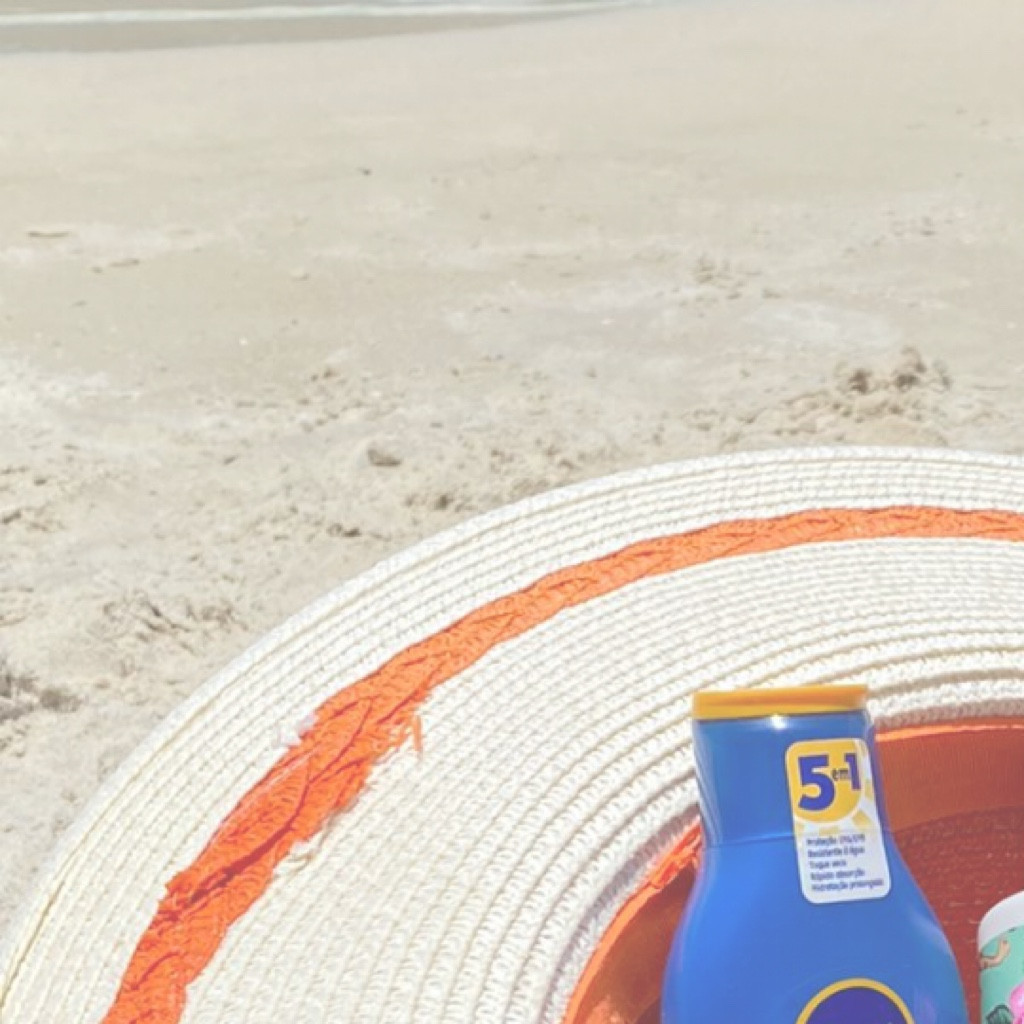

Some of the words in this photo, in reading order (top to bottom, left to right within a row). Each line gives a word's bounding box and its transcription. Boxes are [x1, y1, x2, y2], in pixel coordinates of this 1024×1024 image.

[798, 753, 836, 812] 5
[832, 767, 848, 780] em
[844, 752, 862, 791] 1
